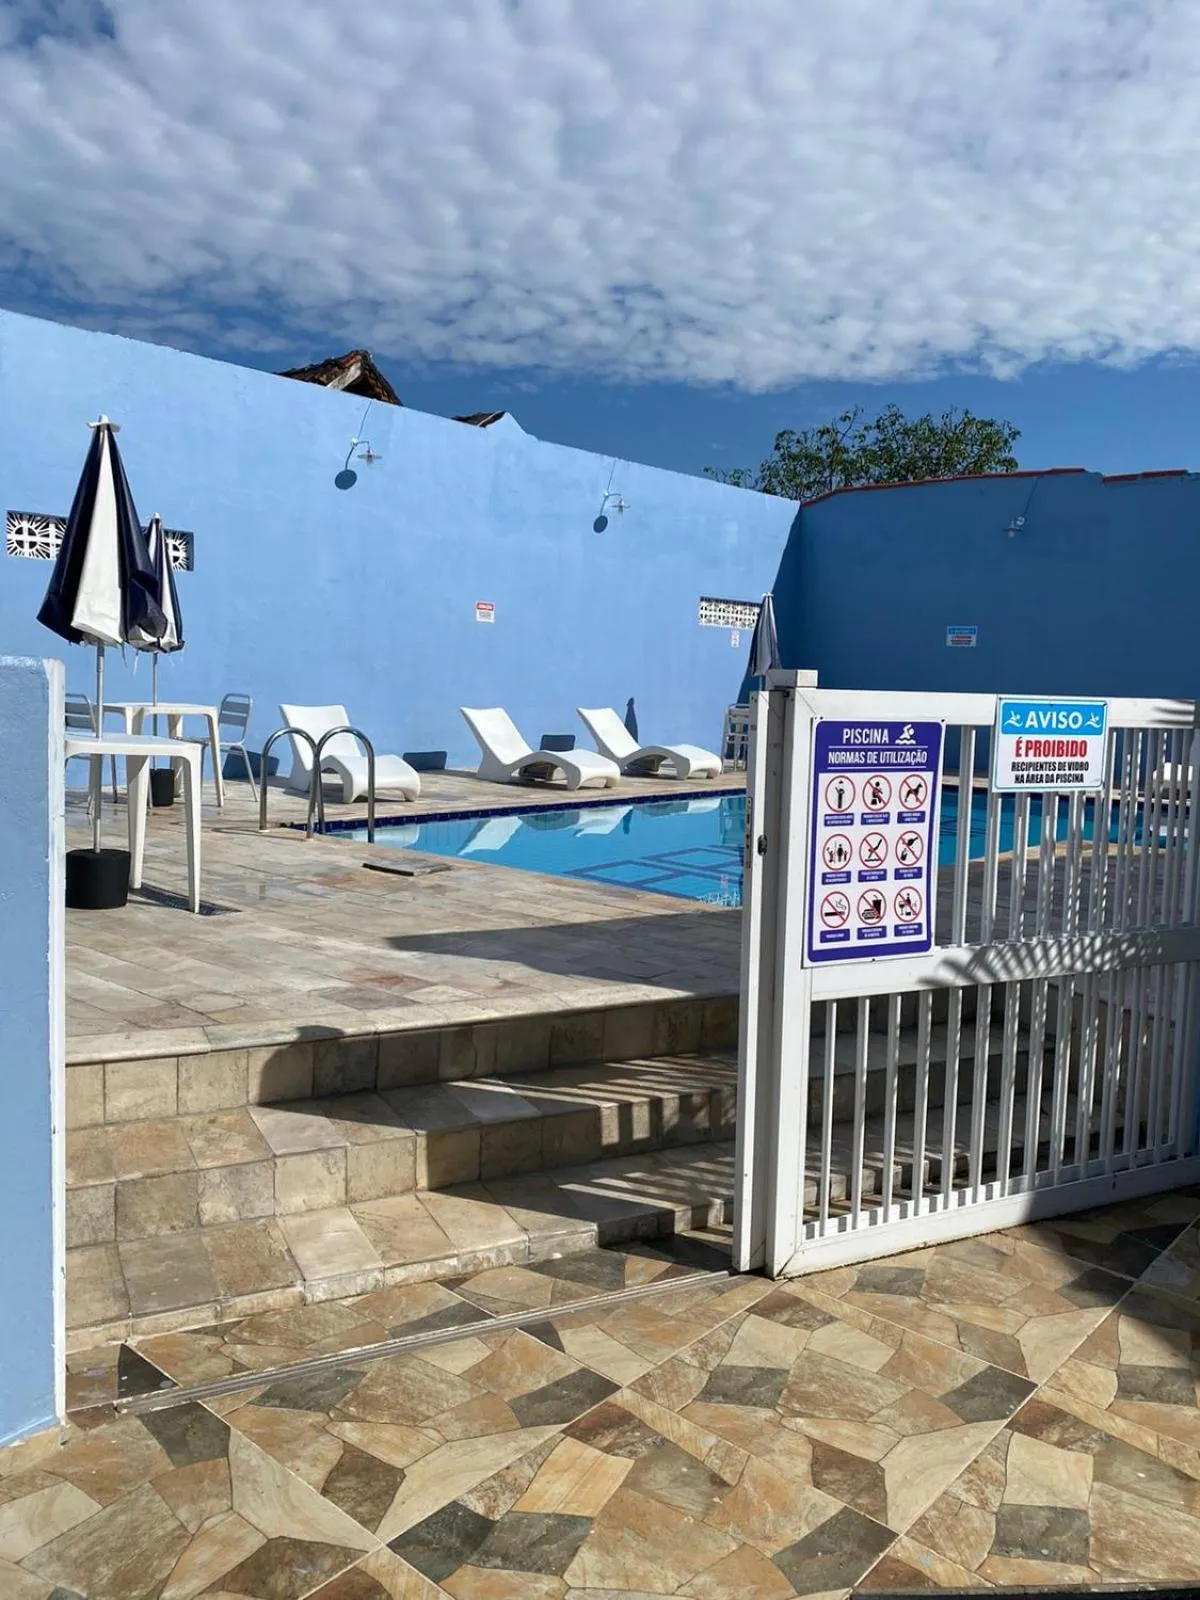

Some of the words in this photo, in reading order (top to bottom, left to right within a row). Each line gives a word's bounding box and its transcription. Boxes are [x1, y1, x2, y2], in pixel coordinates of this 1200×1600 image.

[1024, 710, 1083, 729] AVISO
[842, 728, 890, 744] PISCINA
[1015, 736, 1023, 757] É
[1024, 739, 1088, 758] PROIBIDO
[827, 751, 865, 764] NORMAS
[867, 751, 878, 764] DE
[880, 749, 928, 766] UTILIZAÇÃO
[1011, 761, 1057, 772] RECIPIENTES
[1058, 761, 1067, 771] DE
[1067, 761, 1090, 772] VIDRO
[1014, 774, 1025, 784] NA
[1026, 771, 1044, 784] ÁREA
[1045, 774, 1055, 784] DA
[1056, 773, 1084, 784] PISCINA
